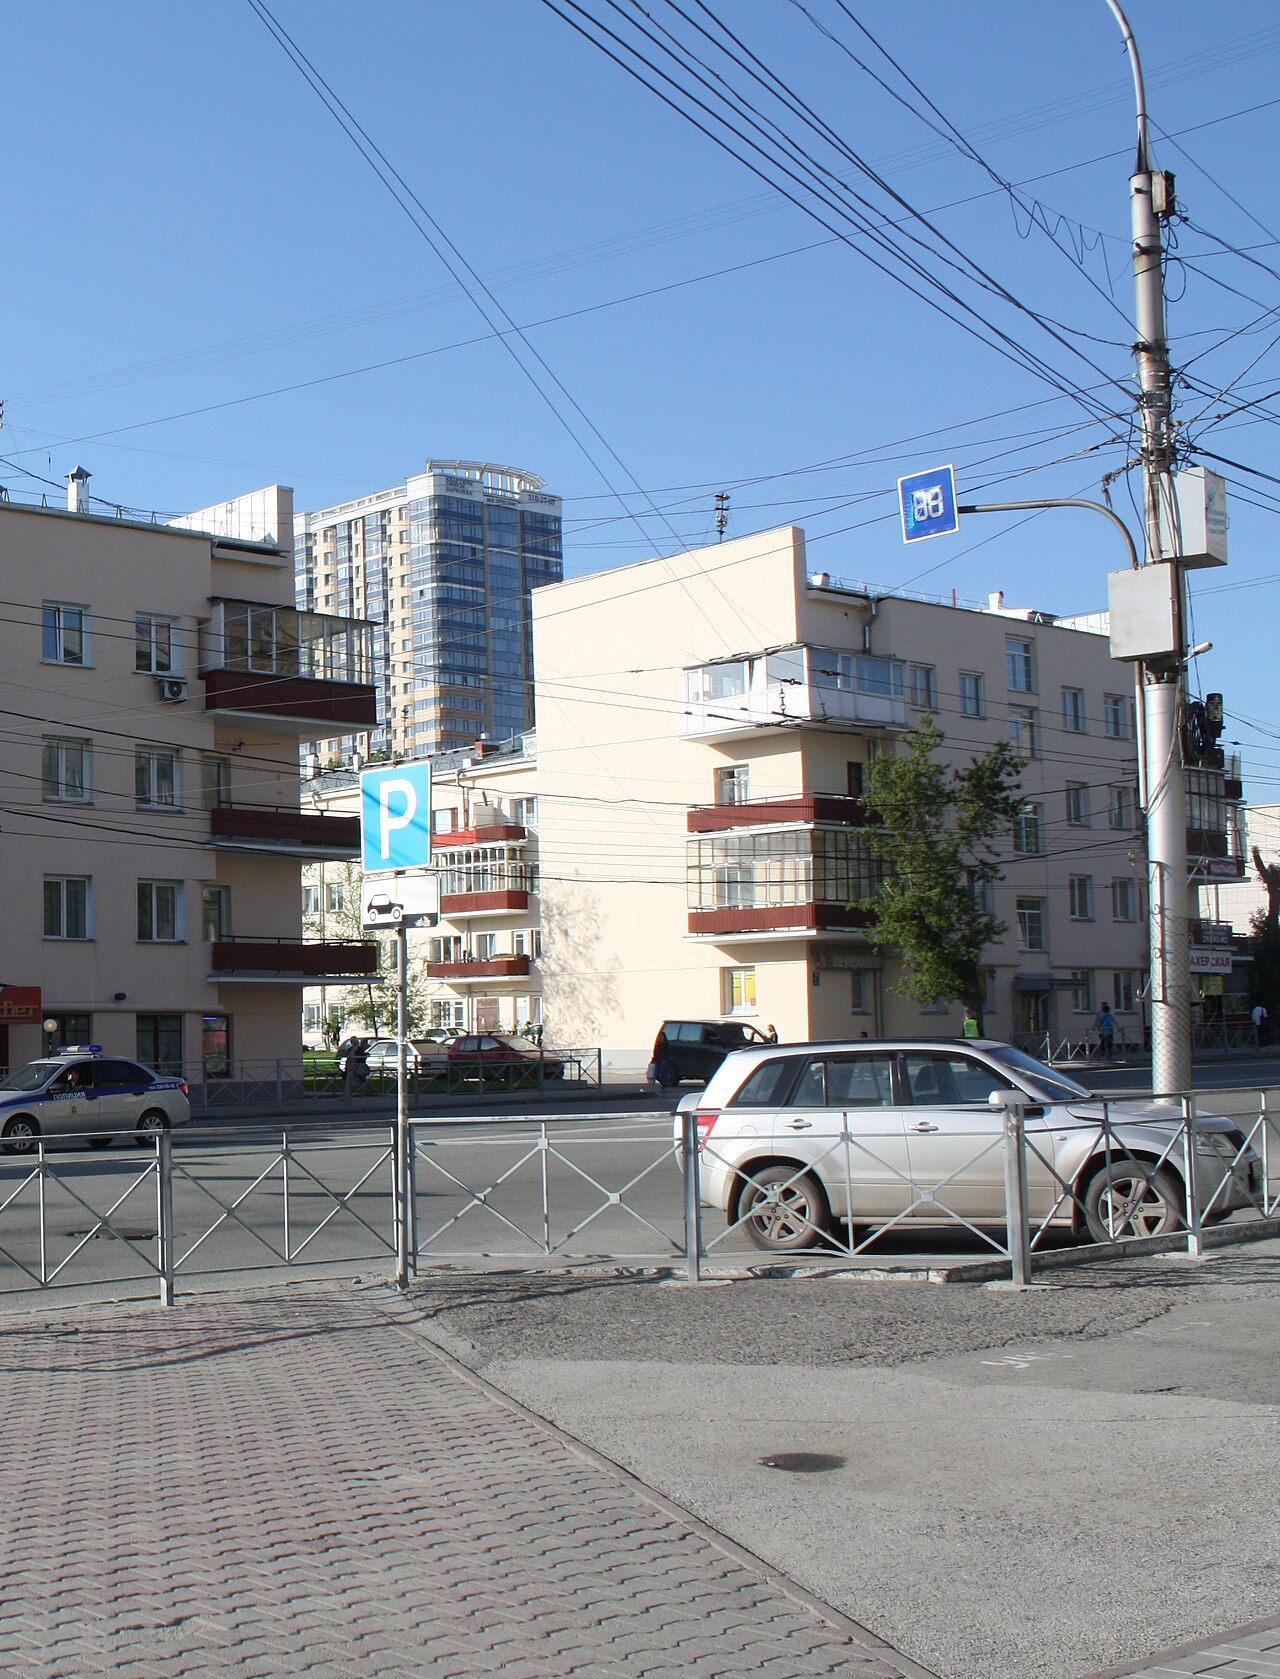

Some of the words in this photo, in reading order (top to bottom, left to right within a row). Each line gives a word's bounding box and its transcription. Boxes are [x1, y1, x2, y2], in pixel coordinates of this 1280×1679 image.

[446, 487, 472, 495] ПАРКОВКА
[379, 778, 417, 861] P
[1190, 956, 1231, 967] АХЕРСКАЯ
[53, 1091, 86, 1100] ПОЛИЦИЯ
